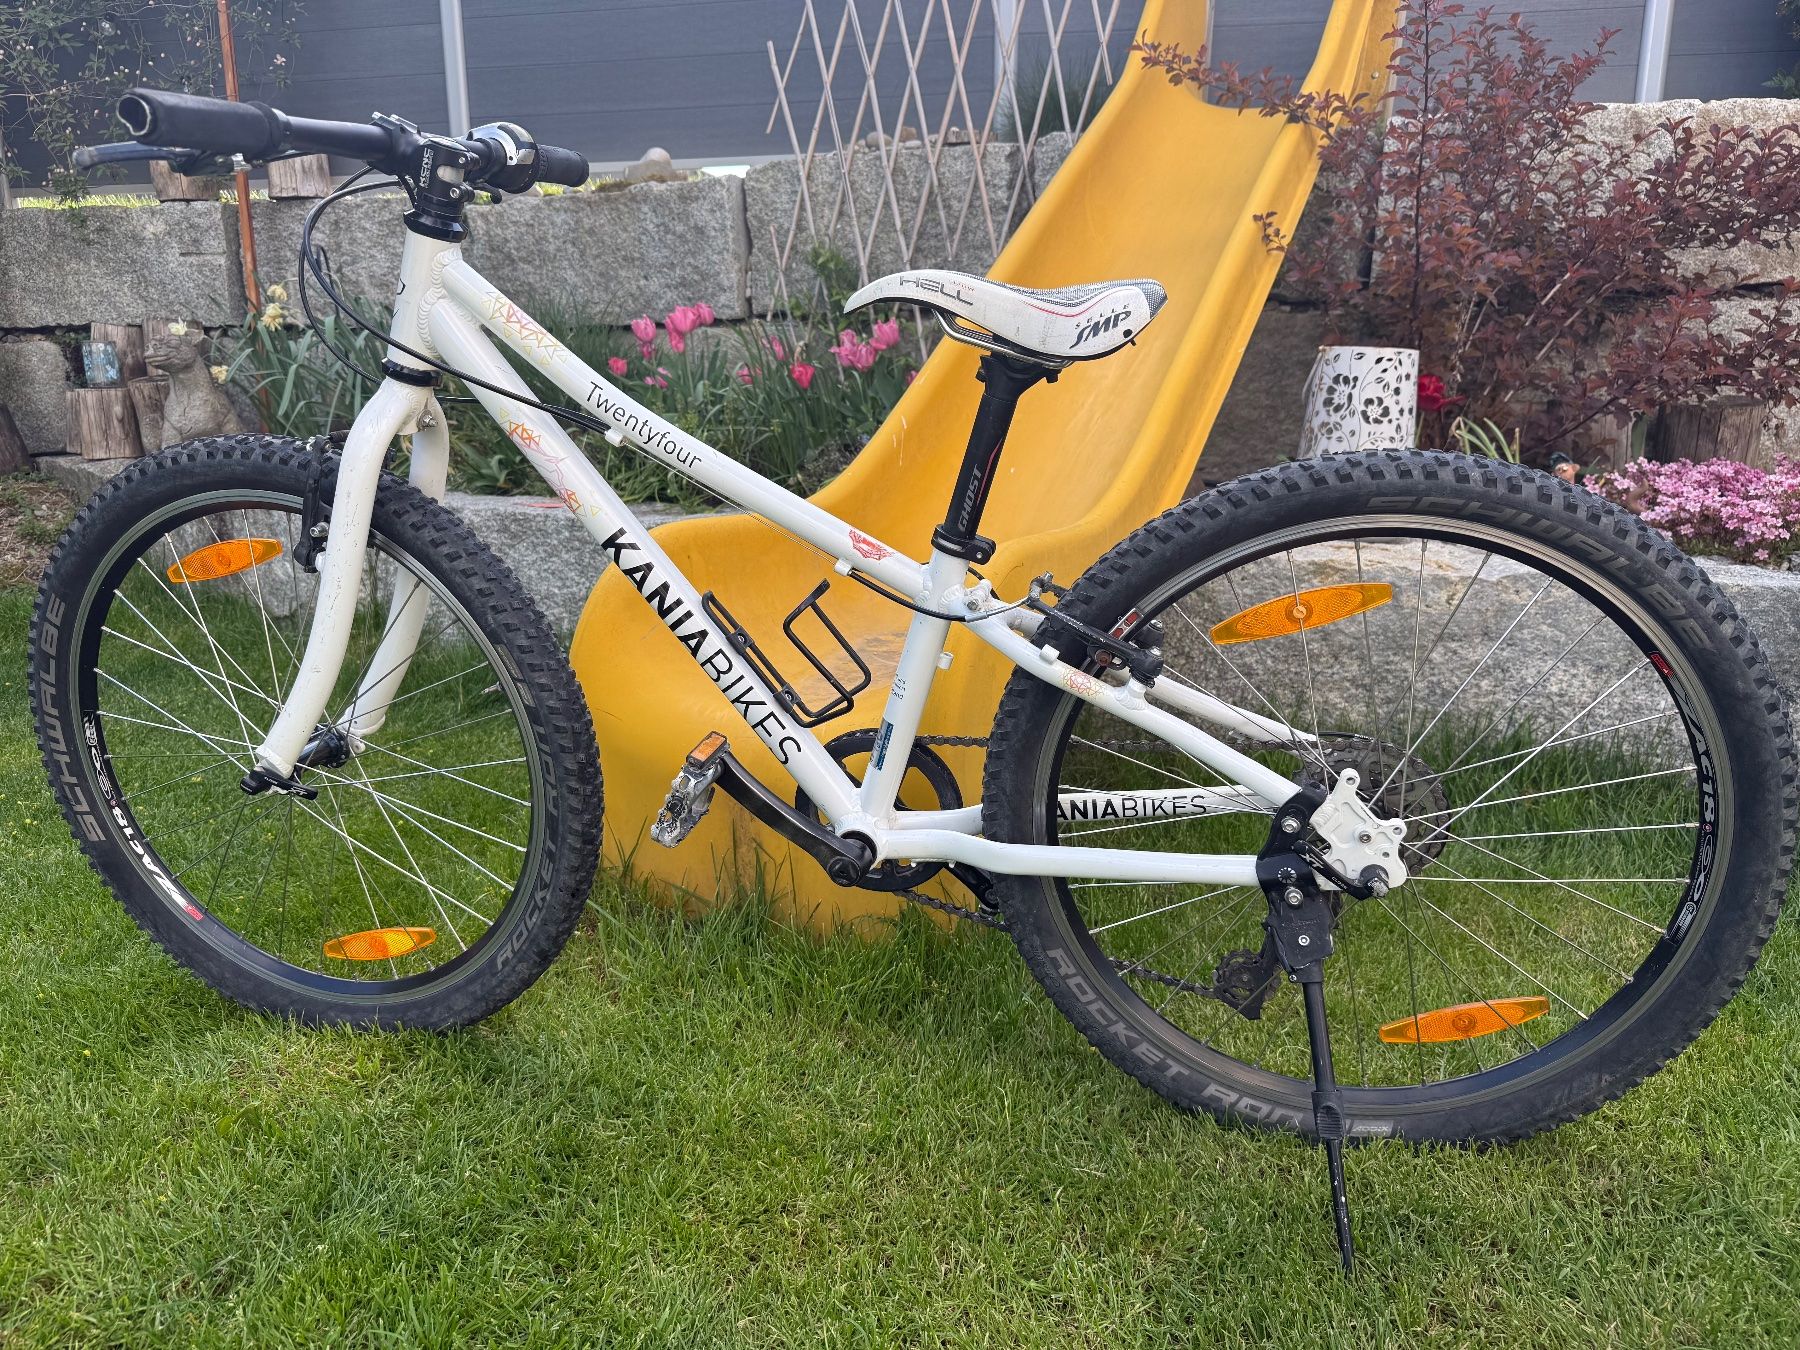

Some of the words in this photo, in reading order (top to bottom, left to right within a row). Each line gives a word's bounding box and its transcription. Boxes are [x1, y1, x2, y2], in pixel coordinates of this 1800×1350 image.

[419, 147, 431, 188] KCNC
[899, 276, 974, 306] HELL
[1069, 310, 1132, 349] SMP
[586, 381, 702, 469] Twentyfour
[957, 463, 982, 532] GHOST
[1366, 496, 1710, 650] SCHWALBE
[600, 527, 802, 765] KANIABIKES
[40, 596, 107, 842] SCHWALBE
[1057, 795, 1207, 821] ANIABIKES
[497, 827, 557, 971] ROCKET
[1049, 950, 1191, 1078] ROCKET
